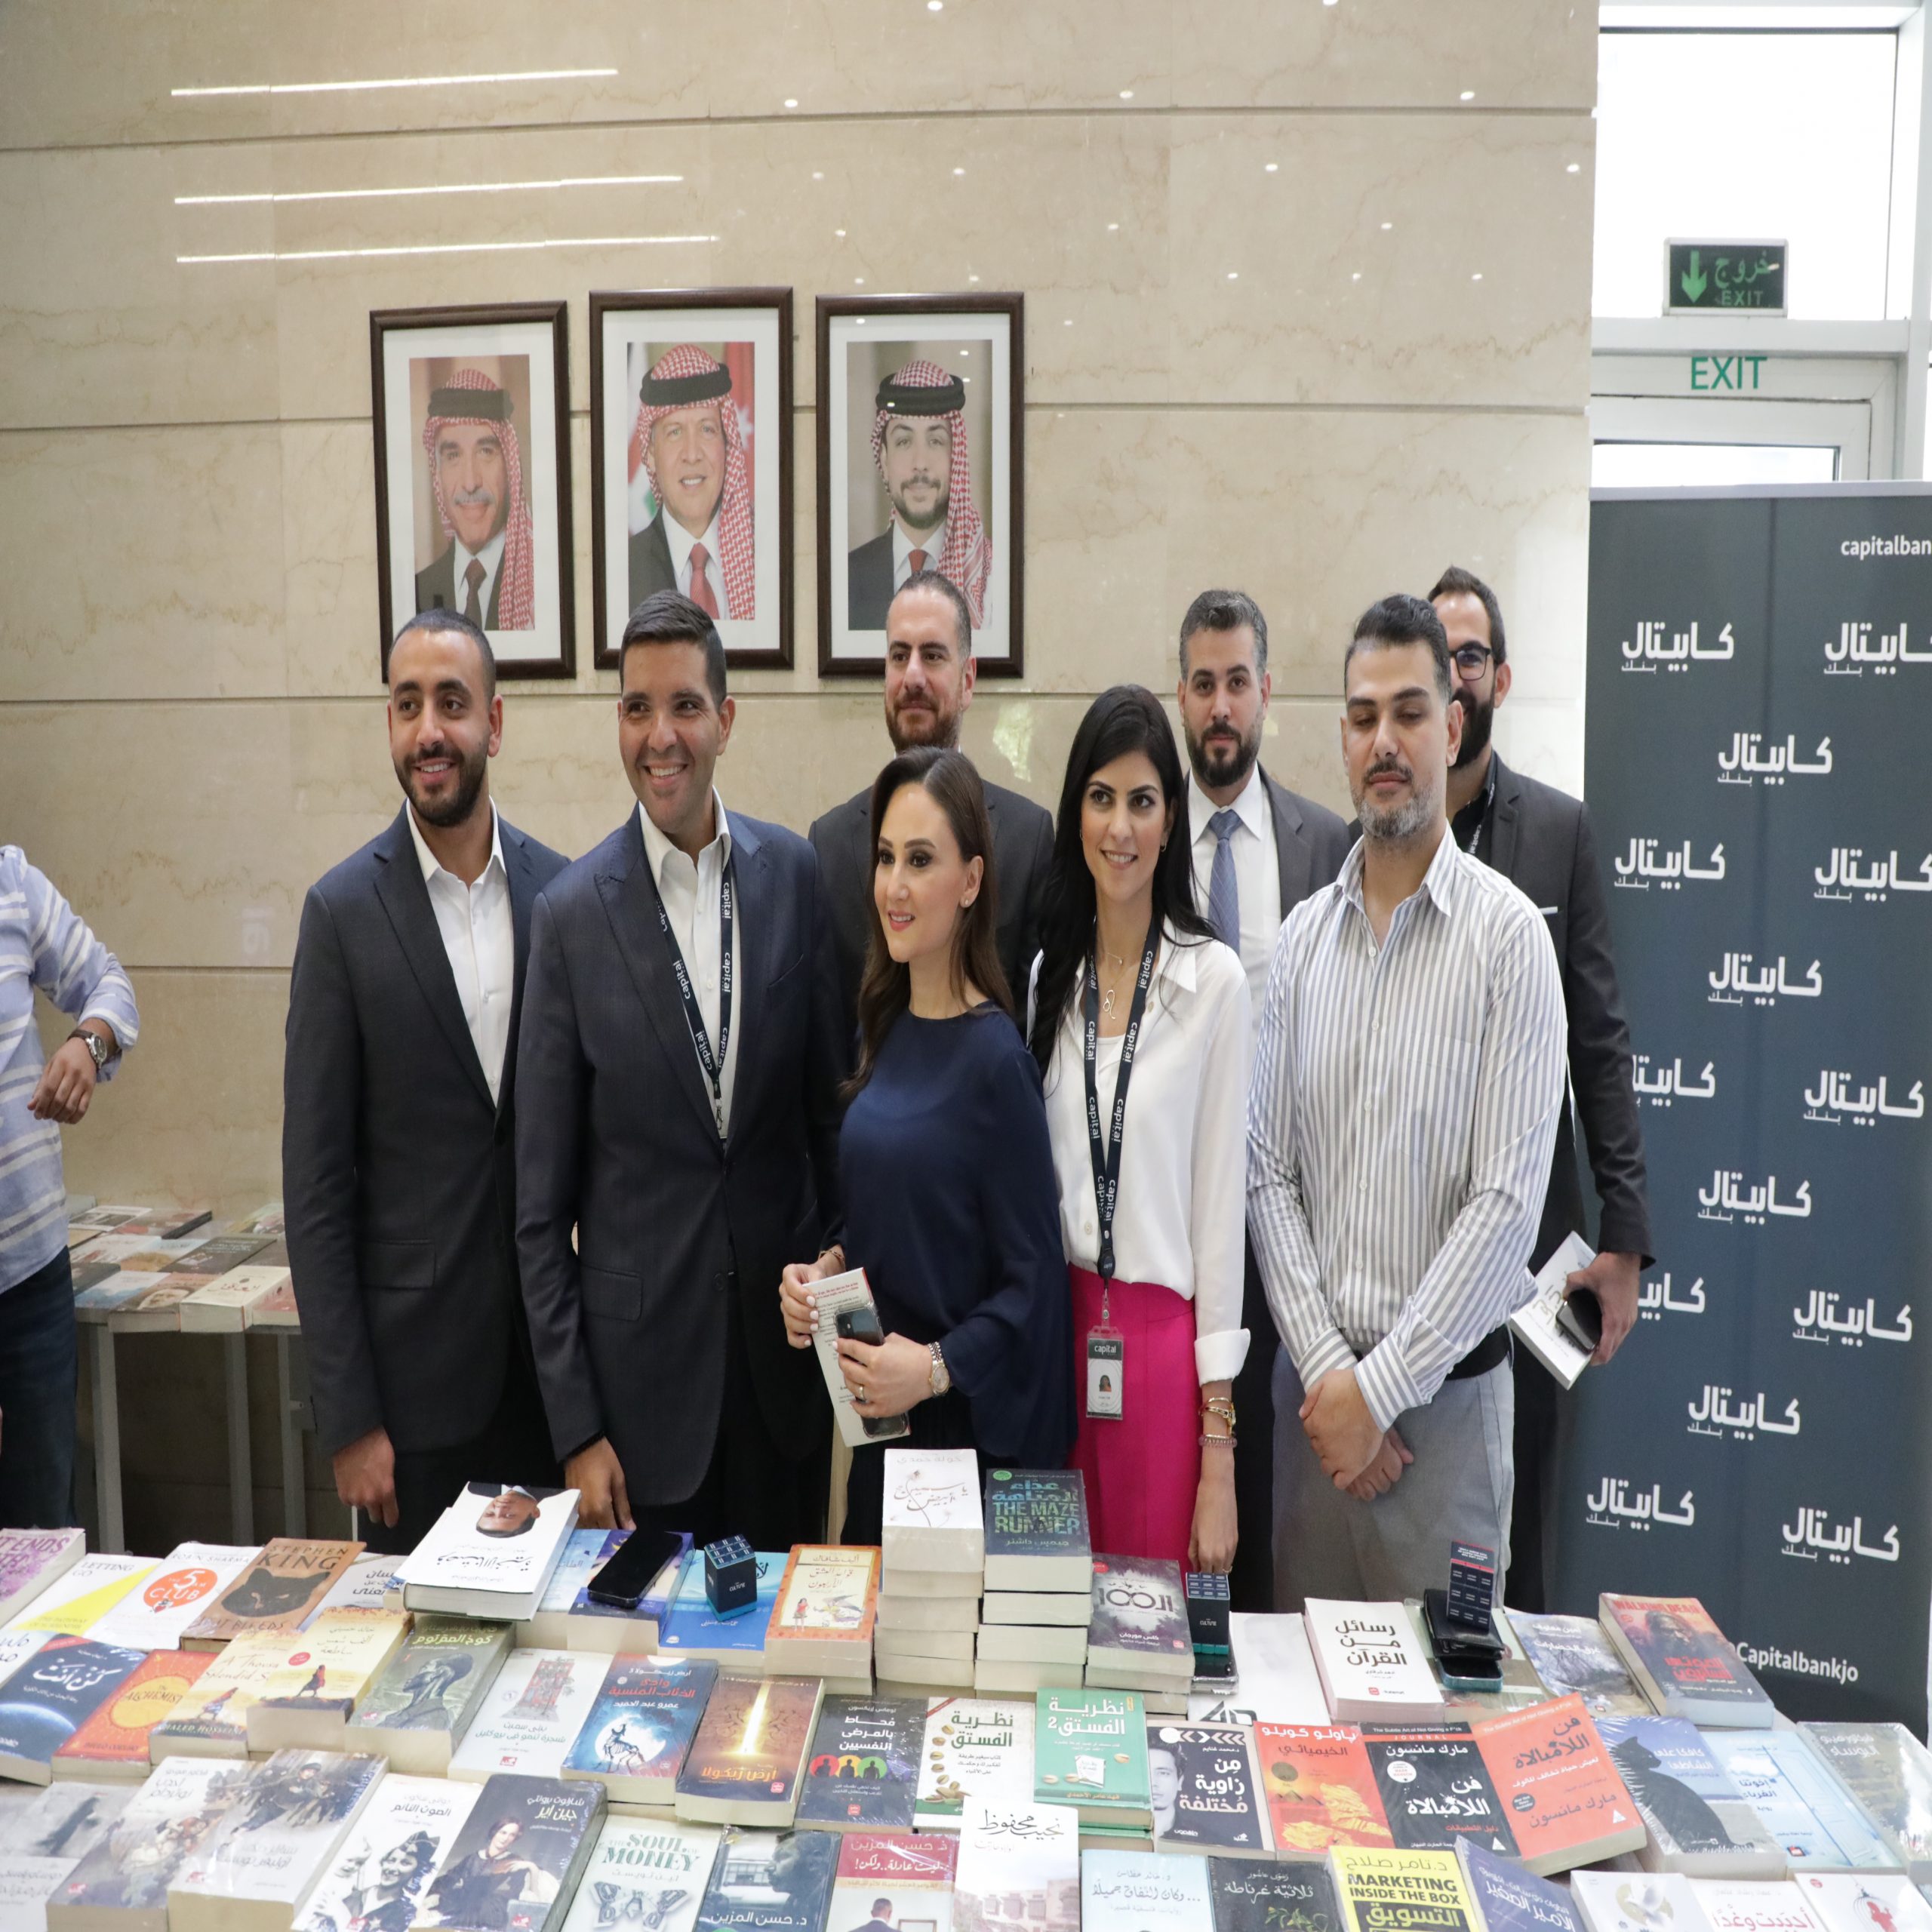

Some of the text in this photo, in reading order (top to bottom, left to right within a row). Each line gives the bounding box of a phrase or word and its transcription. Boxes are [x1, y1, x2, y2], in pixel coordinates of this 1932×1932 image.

[1721, 291, 1763, 306] EXIT
[1690, 356, 1767, 389] EXIT
[1622, 622, 1734, 672] كابيتال
[1718, 733, 1832, 785] كابيتال
[1614, 838, 1725, 889] كابيتال
[723, 881, 731, 919] capital
[1140, 950, 1153, 990] capital
[1709, 952, 1823, 1006] كابيتال
[1087, 1020, 1095, 1060] capital
[1125, 1022, 1137, 1063] capital
[1804, 1071, 1924, 1126] كابيتال
[1089, 1097, 1100, 1139] capital
[1112, 1098, 1123, 1143] capital
[1699, 1171, 1811, 1225] كابيتال
[1793, 1290, 1913, 1346] كابيتال
[1094, 1344, 1116, 1355] capital
[1688, 1385, 1801, 1441] كابيتال
[992, 1502, 1079, 1517] THE MAZE
[1586, 1477, 1695, 1531] كابيتال
[995, 1517, 1080, 1534] RUNNER
[1782, 1507, 1900, 1564] كابيتال
[11, 1537, 70, 1554] ENDS
[269, 1545, 349, 1555] STEPHEN
[79, 1560, 134, 1571] LETTING
[206, 1555, 250, 1564] SHARMA
[259, 1555, 342, 1570] KING
[174, 1571, 205, 1589] 5
[149, 1588, 198, 1601] CLUB
[1335, 1620, 1396, 1635] رسائل
[1340, 1635, 1401, 1648] من
[1347, 1648, 1407, 1666] القرآن
[1733, 1641, 1859, 1685] Capitalbankjo
[125, 1690, 183, 1706] ALCHEMIST
[1049, 1696, 1125, 1717] نظرية
[951, 1710, 1014, 1729] نظرية
[1057, 1717, 1125, 1737] الفستق
[1554, 1714, 1581, 1736] فن
[951, 1731, 1013, 1749] الفستق
[1261, 1725, 1309, 1738] كويلو
[1386, 1743, 1469, 1757] مارك مانسون
[746, 1767, 778, 1782] أرض
[1451, 1776, 1483, 1792] فن
[1195, 1774, 1245, 1795] زاوية
[977, 1807, 1038, 1836] محفوظ
[626, 1833, 684, 1852] SOUL
[601, 1847, 701, 1872] MONEY
[1347, 1873, 1458, 1892] MARKETING
[1349, 1887, 1461, 1905] INSIDE THE BOX
[709, 1909, 754, 1924] المزين
[755, 1913, 792, 1927] حسن
[1365, 1902, 1461, 1928] التسويق
